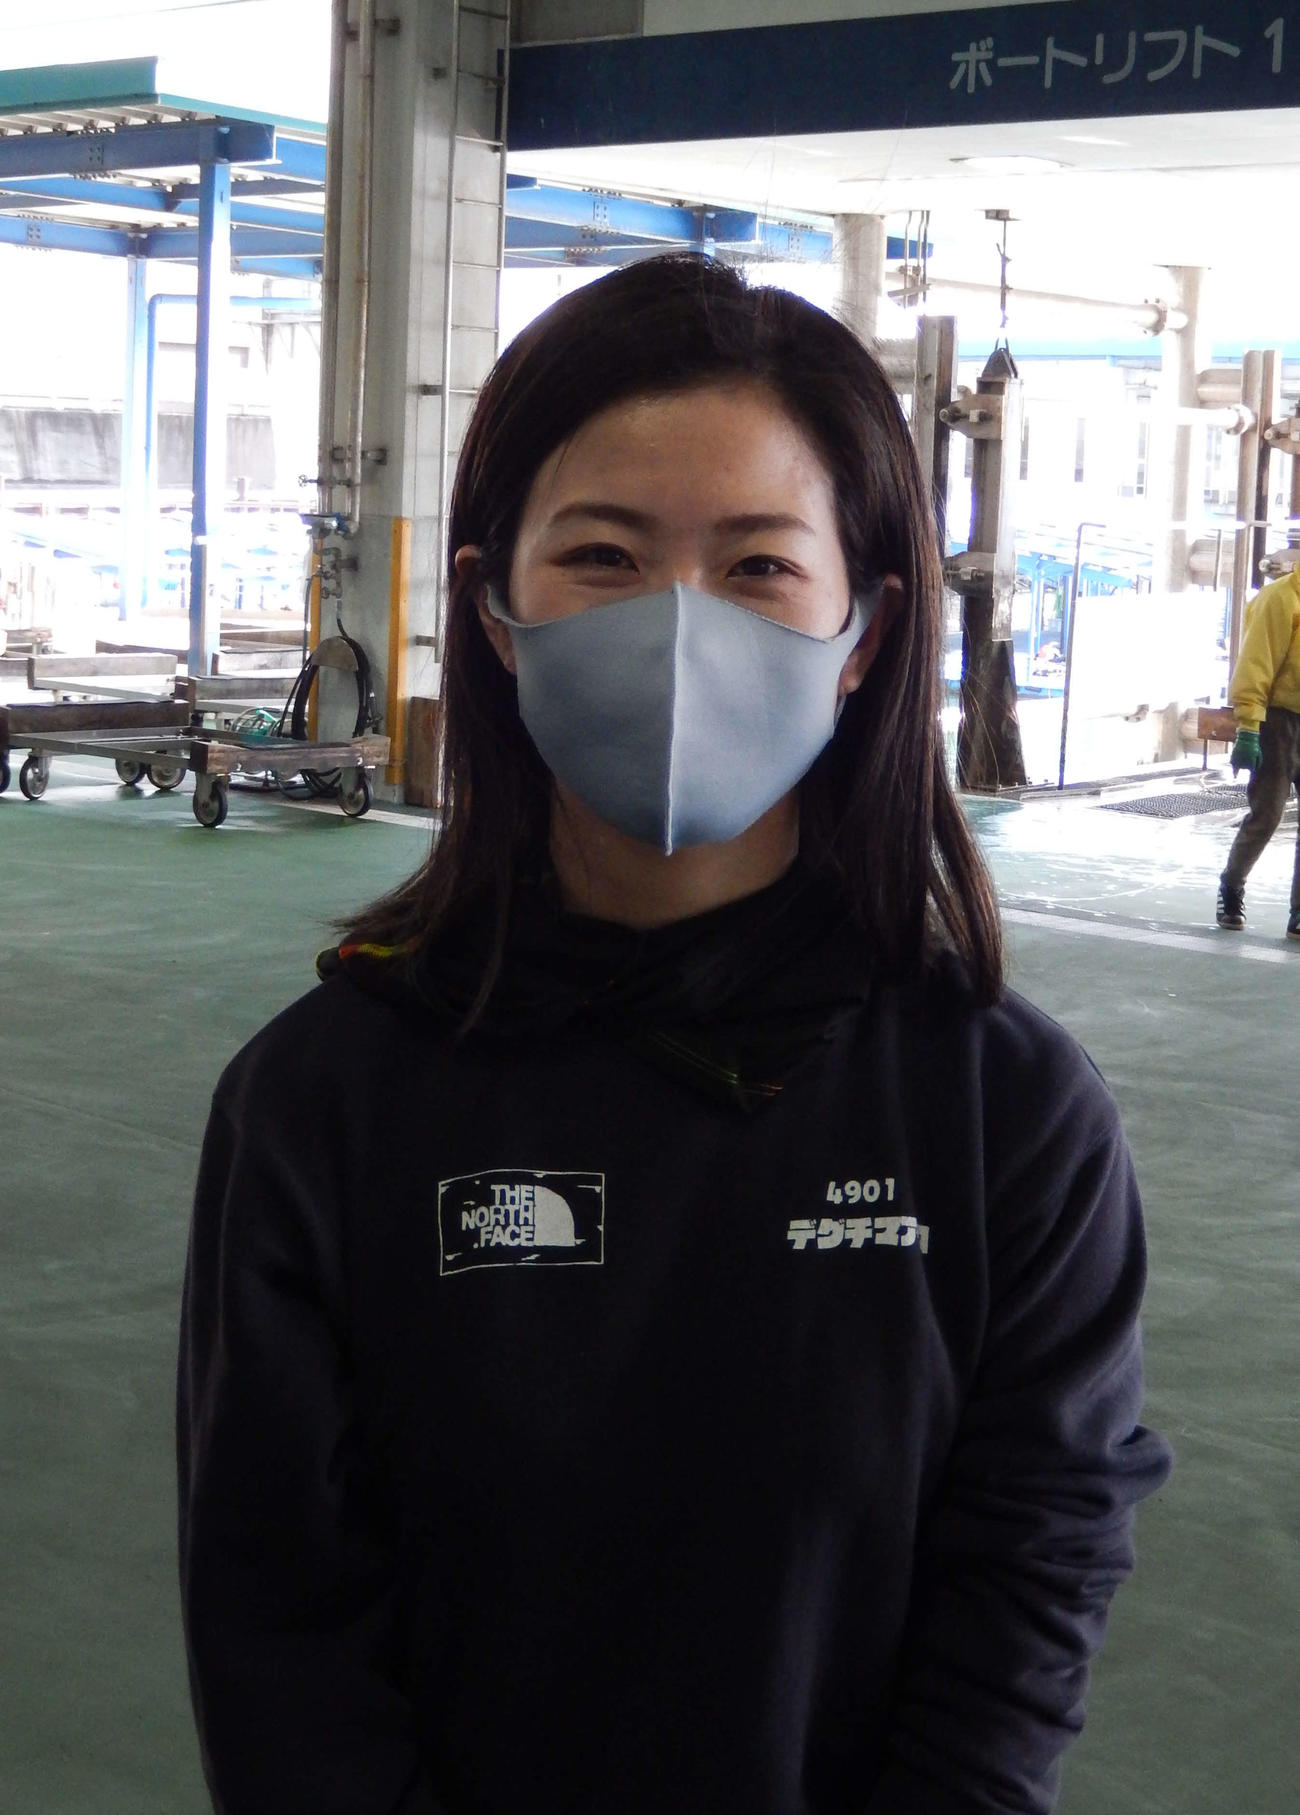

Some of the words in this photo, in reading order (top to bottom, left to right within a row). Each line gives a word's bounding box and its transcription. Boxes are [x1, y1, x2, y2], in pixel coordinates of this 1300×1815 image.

[950, 25, 1241, 94] ボートリフト
[1264, 17, 1284, 74] 1
[490, 1184, 535, 1206] THE
[826, 1177, 896, 1205] 4901
[461, 1203, 535, 1231] NORTH
[480, 1225, 535, 1248] FACE
